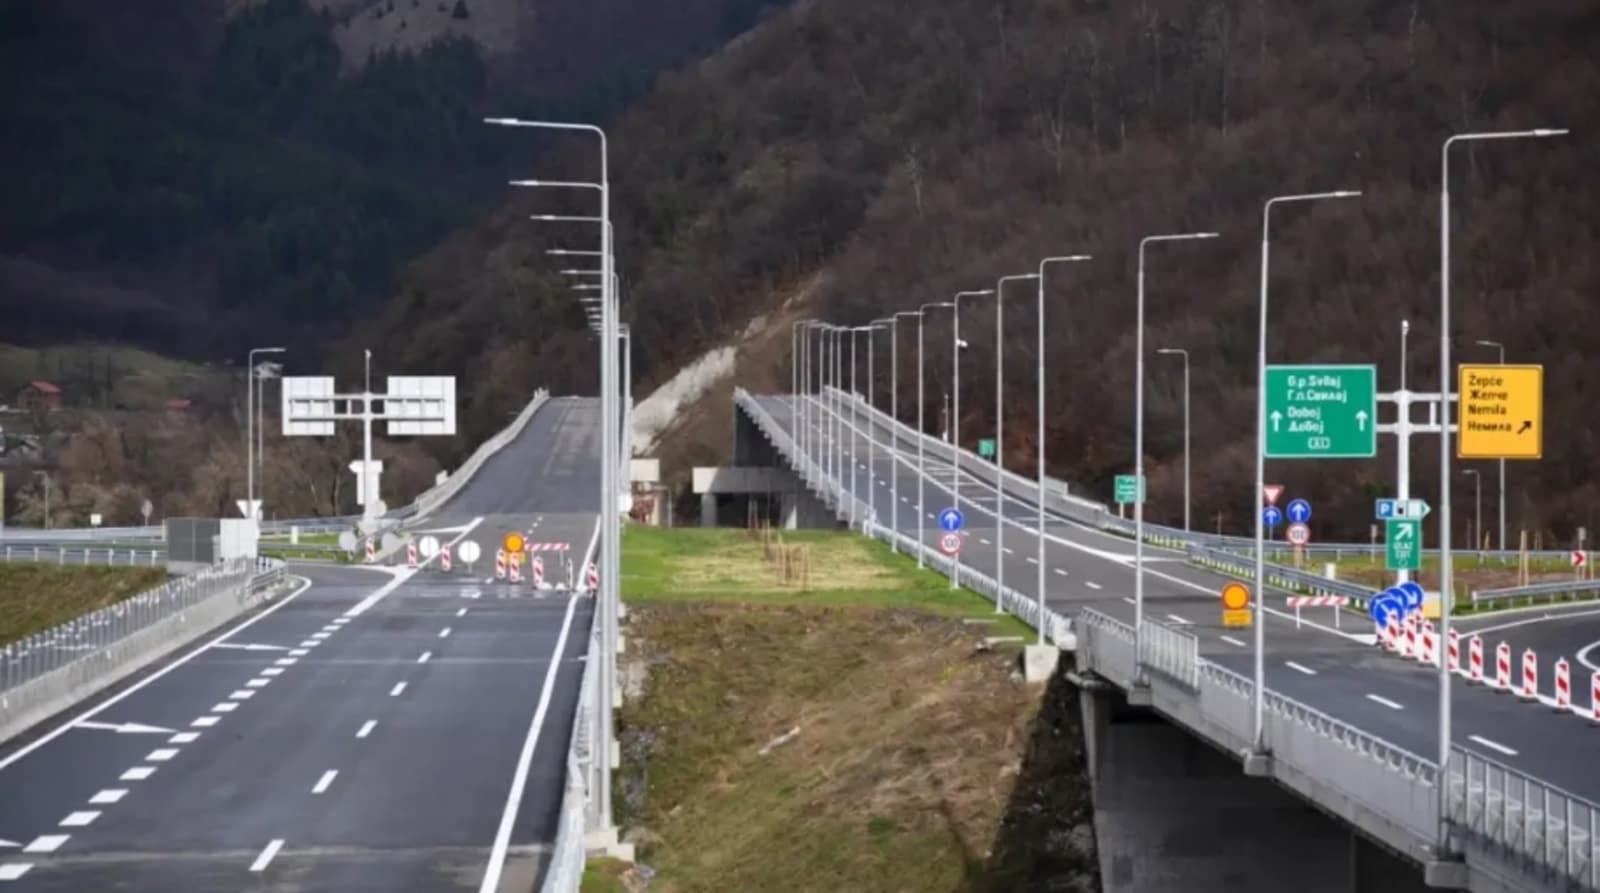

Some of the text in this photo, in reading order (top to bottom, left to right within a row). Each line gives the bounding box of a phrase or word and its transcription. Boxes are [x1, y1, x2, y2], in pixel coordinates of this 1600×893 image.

[1287, 406, 1321, 421] Doboj
[1468, 404, 1507, 415] Nemila
[1467, 421, 1512, 432] Немила
[1380, 503, 1390, 515] P
